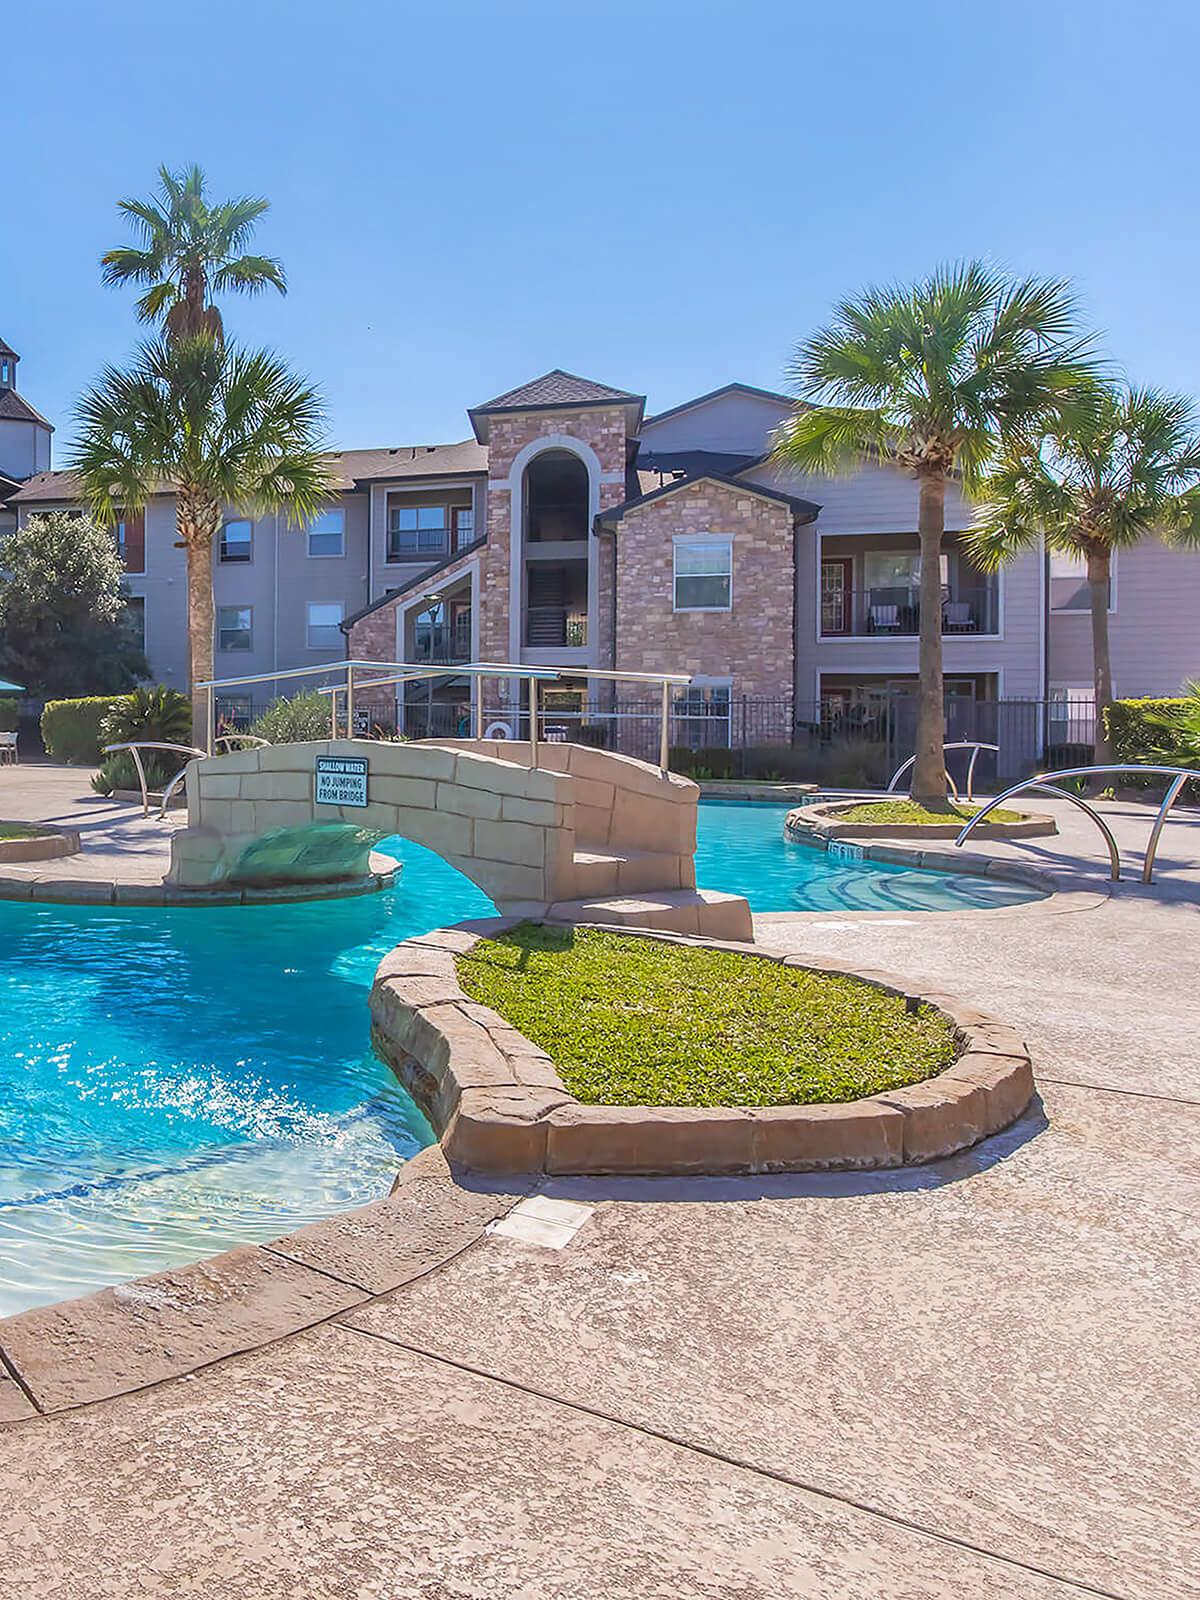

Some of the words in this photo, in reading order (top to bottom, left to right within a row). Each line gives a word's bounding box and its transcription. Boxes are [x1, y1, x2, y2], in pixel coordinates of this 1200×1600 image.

[319, 761, 344, 772] SHALLOW
[345, 763, 365, 773] WATER
[321, 776, 330, 787] NO
[331, 777, 362, 789] JUMPING
[319, 789, 338, 800] FROM
[339, 790, 364, 802] BRIDGE
